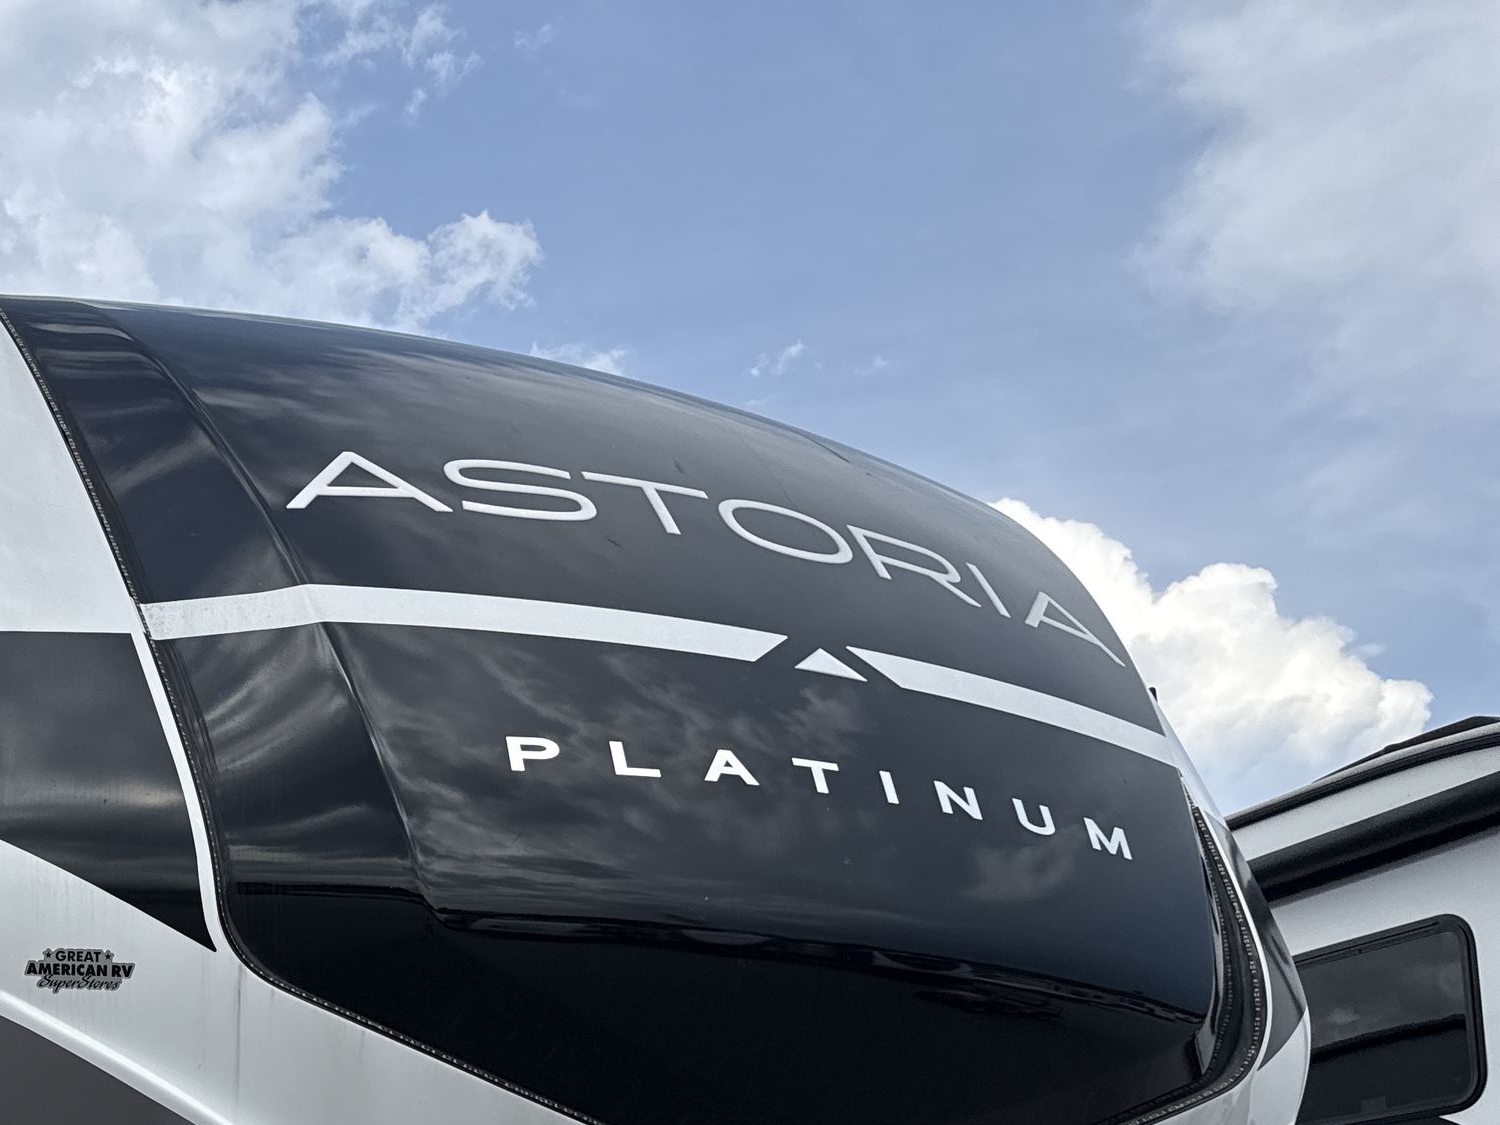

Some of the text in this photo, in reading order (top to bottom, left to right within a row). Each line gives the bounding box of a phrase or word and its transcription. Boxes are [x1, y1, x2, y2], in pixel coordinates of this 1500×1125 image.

[286, 450, 1127, 667] ASTORIA
[505, 735, 1135, 862] PLATINUM
[55, 950, 102, 963] GREAT
[26, 962, 134, 979] AMERICAN RV
[38, 974, 121, 994] SuperStores
